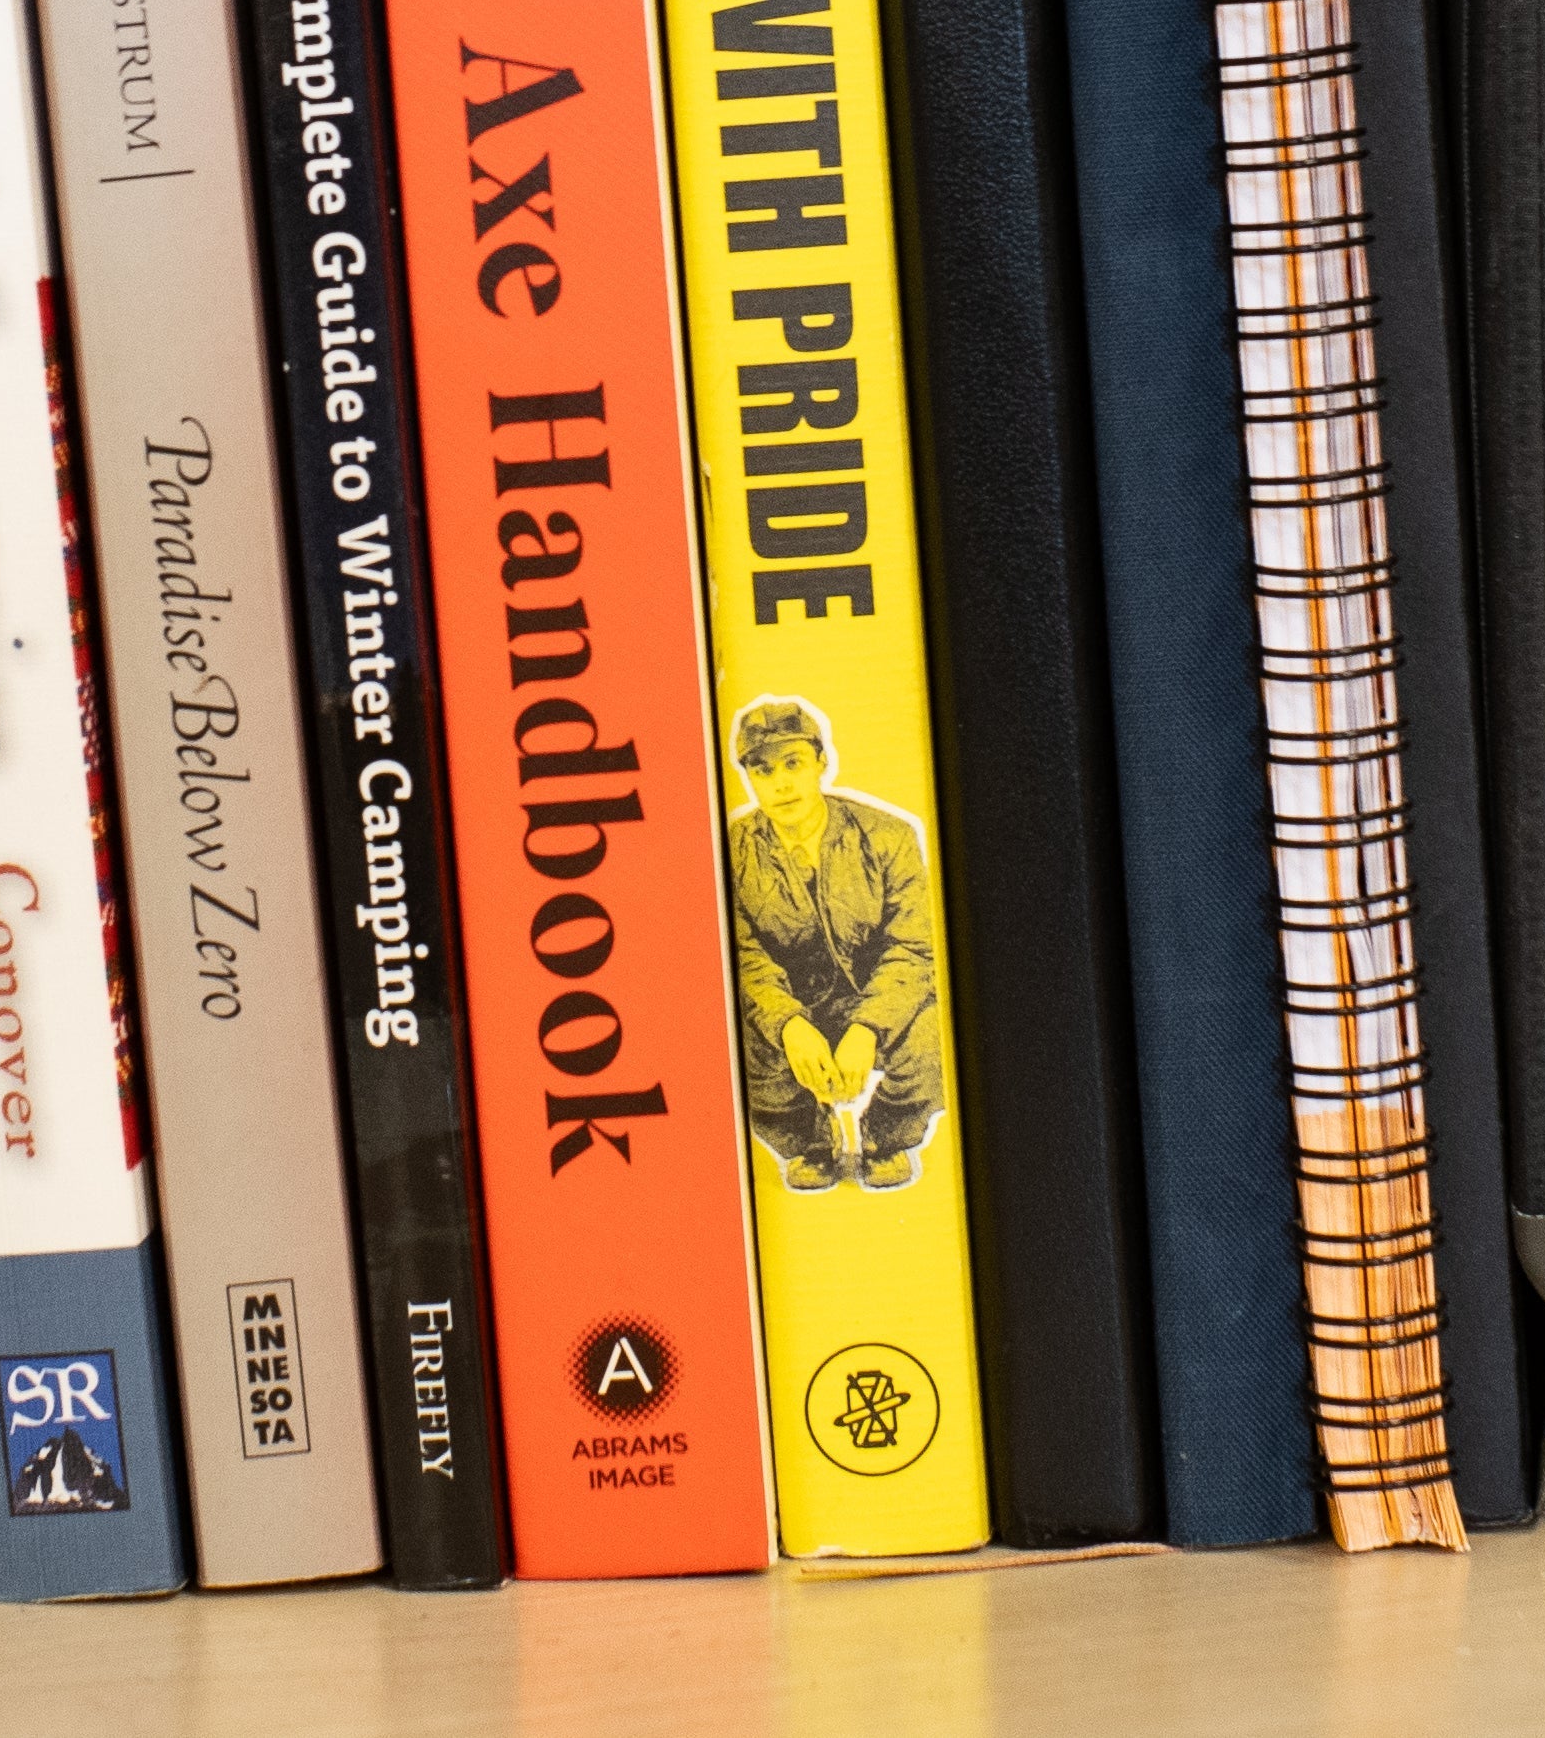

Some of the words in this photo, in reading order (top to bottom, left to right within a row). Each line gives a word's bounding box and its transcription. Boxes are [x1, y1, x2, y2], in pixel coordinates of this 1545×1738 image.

[458, 35, 586, 319] Axe
[312, 231, 377, 424] Guide
[144, 416, 233, 673] Paradise
[328, 436, 377, 503] to
[731, 282, 876, 626] PRIDE
[337, 514, 399, 745] Winter
[171, 675, 251, 873] Below
[487, 381, 669, 1179] Handbook
[190, 886, 261, 1022] Zero
[355, 759, 430, 1049] Camping
[6, 1362, 111, 1436] SR
[571, 1432, 688, 1460] ABRAMS
[588, 1464, 676, 1490] IMAGE
